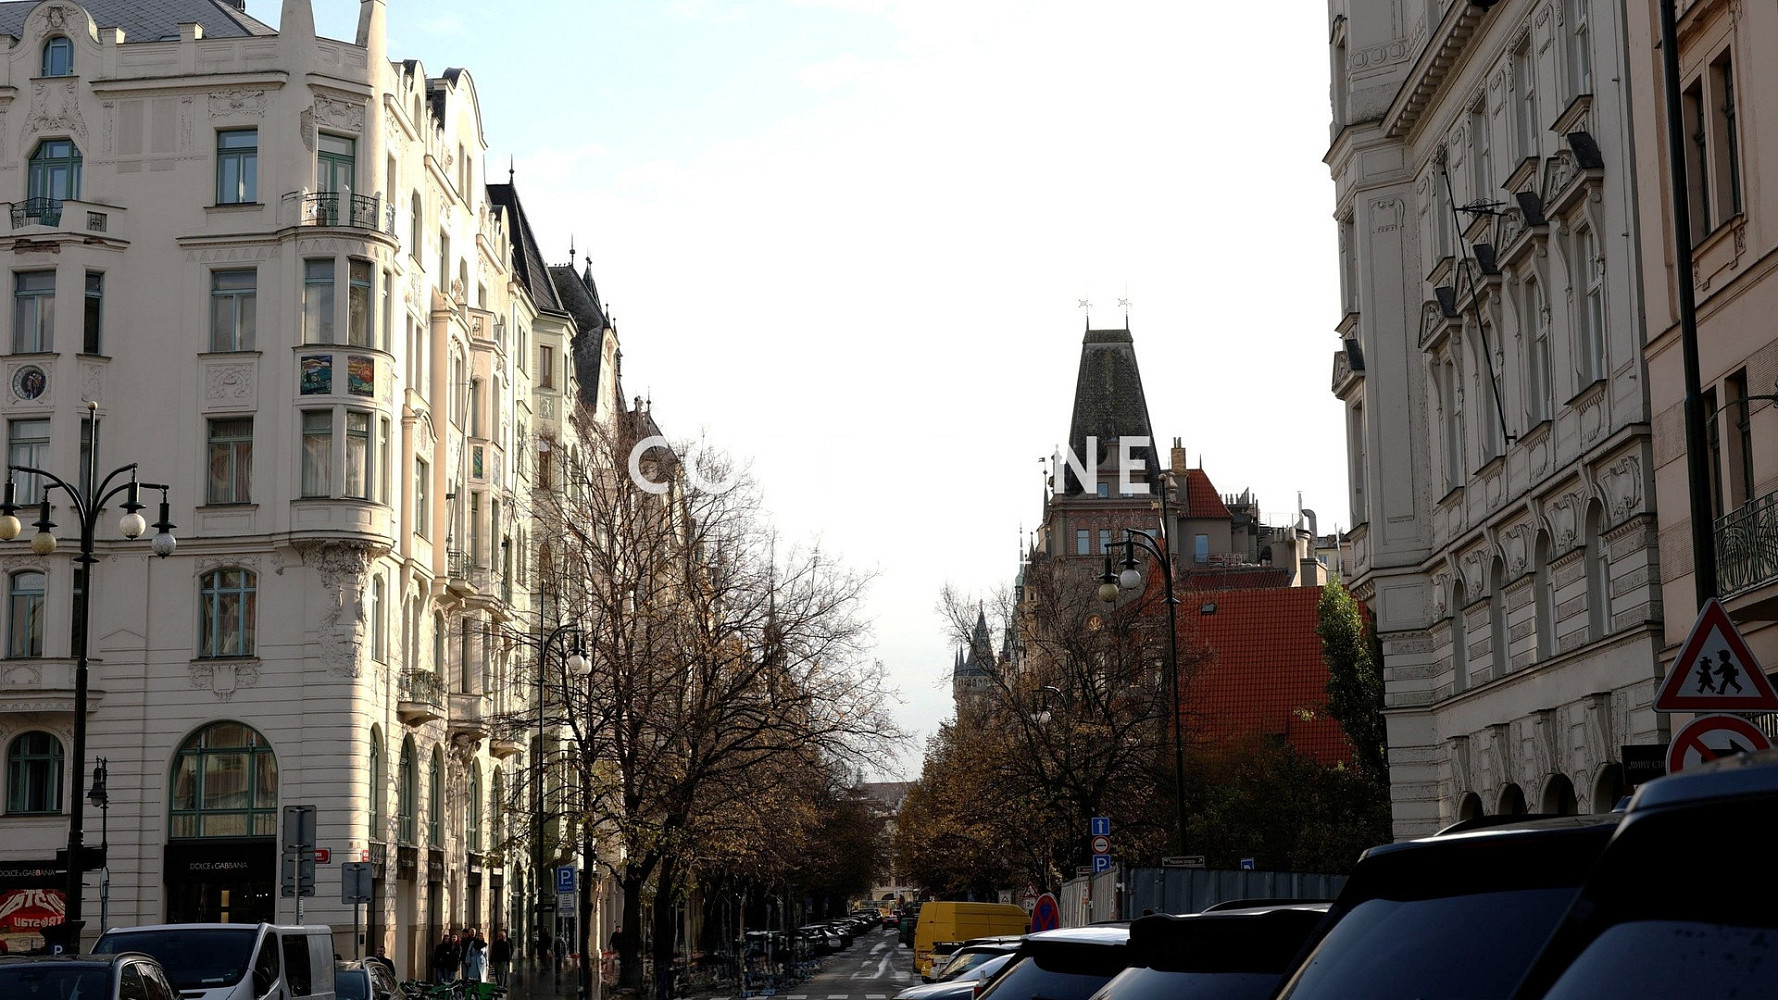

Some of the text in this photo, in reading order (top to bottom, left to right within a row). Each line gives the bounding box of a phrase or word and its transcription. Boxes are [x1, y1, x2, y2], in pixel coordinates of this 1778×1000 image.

[1096, 857, 1107, 873] P
[560, 869, 571, 885] P
[54, 945, 63, 956] P
